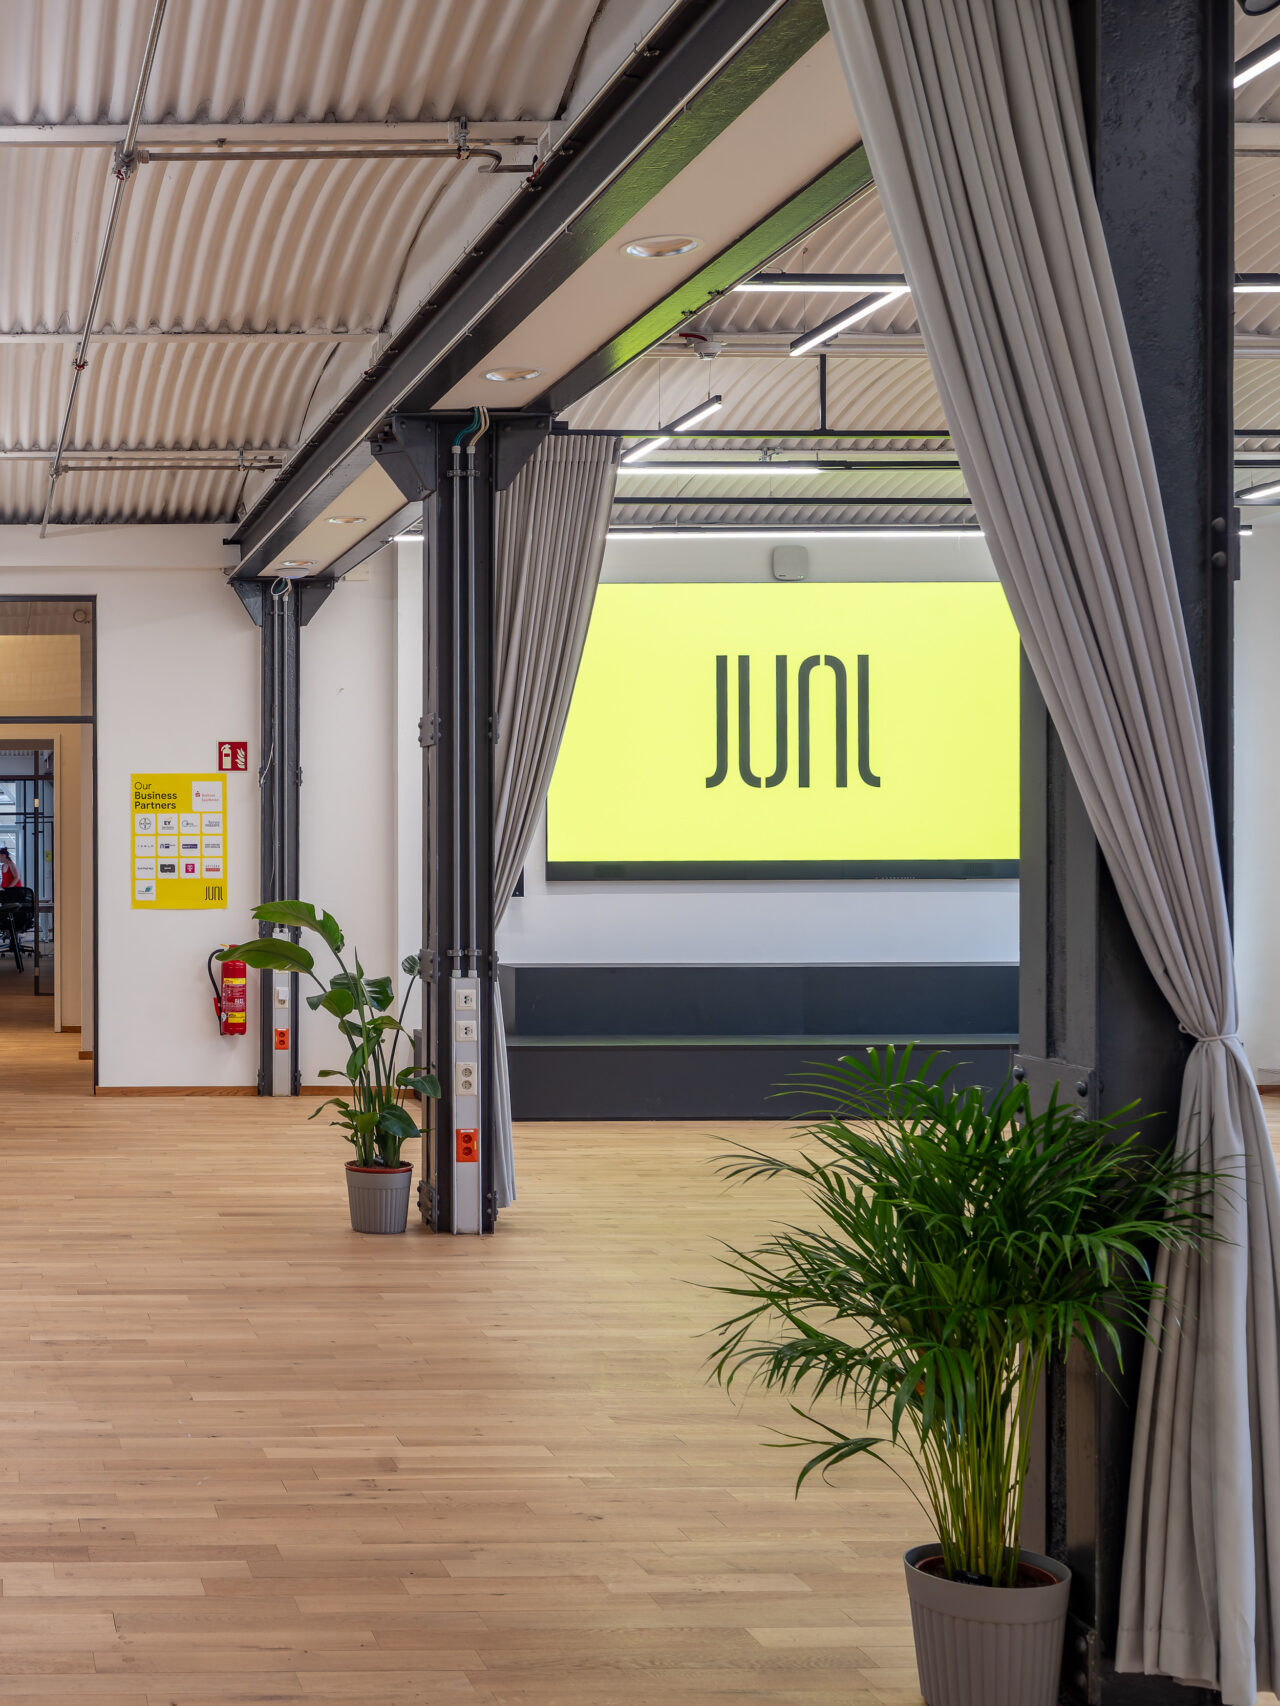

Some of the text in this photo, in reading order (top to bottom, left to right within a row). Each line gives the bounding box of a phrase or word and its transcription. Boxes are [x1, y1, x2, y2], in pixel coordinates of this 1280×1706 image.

[705, 654, 881, 788] JUNI
[134, 781, 152, 790] Our
[134, 791, 178, 800] Business
[134, 801, 177, 810] Partners
